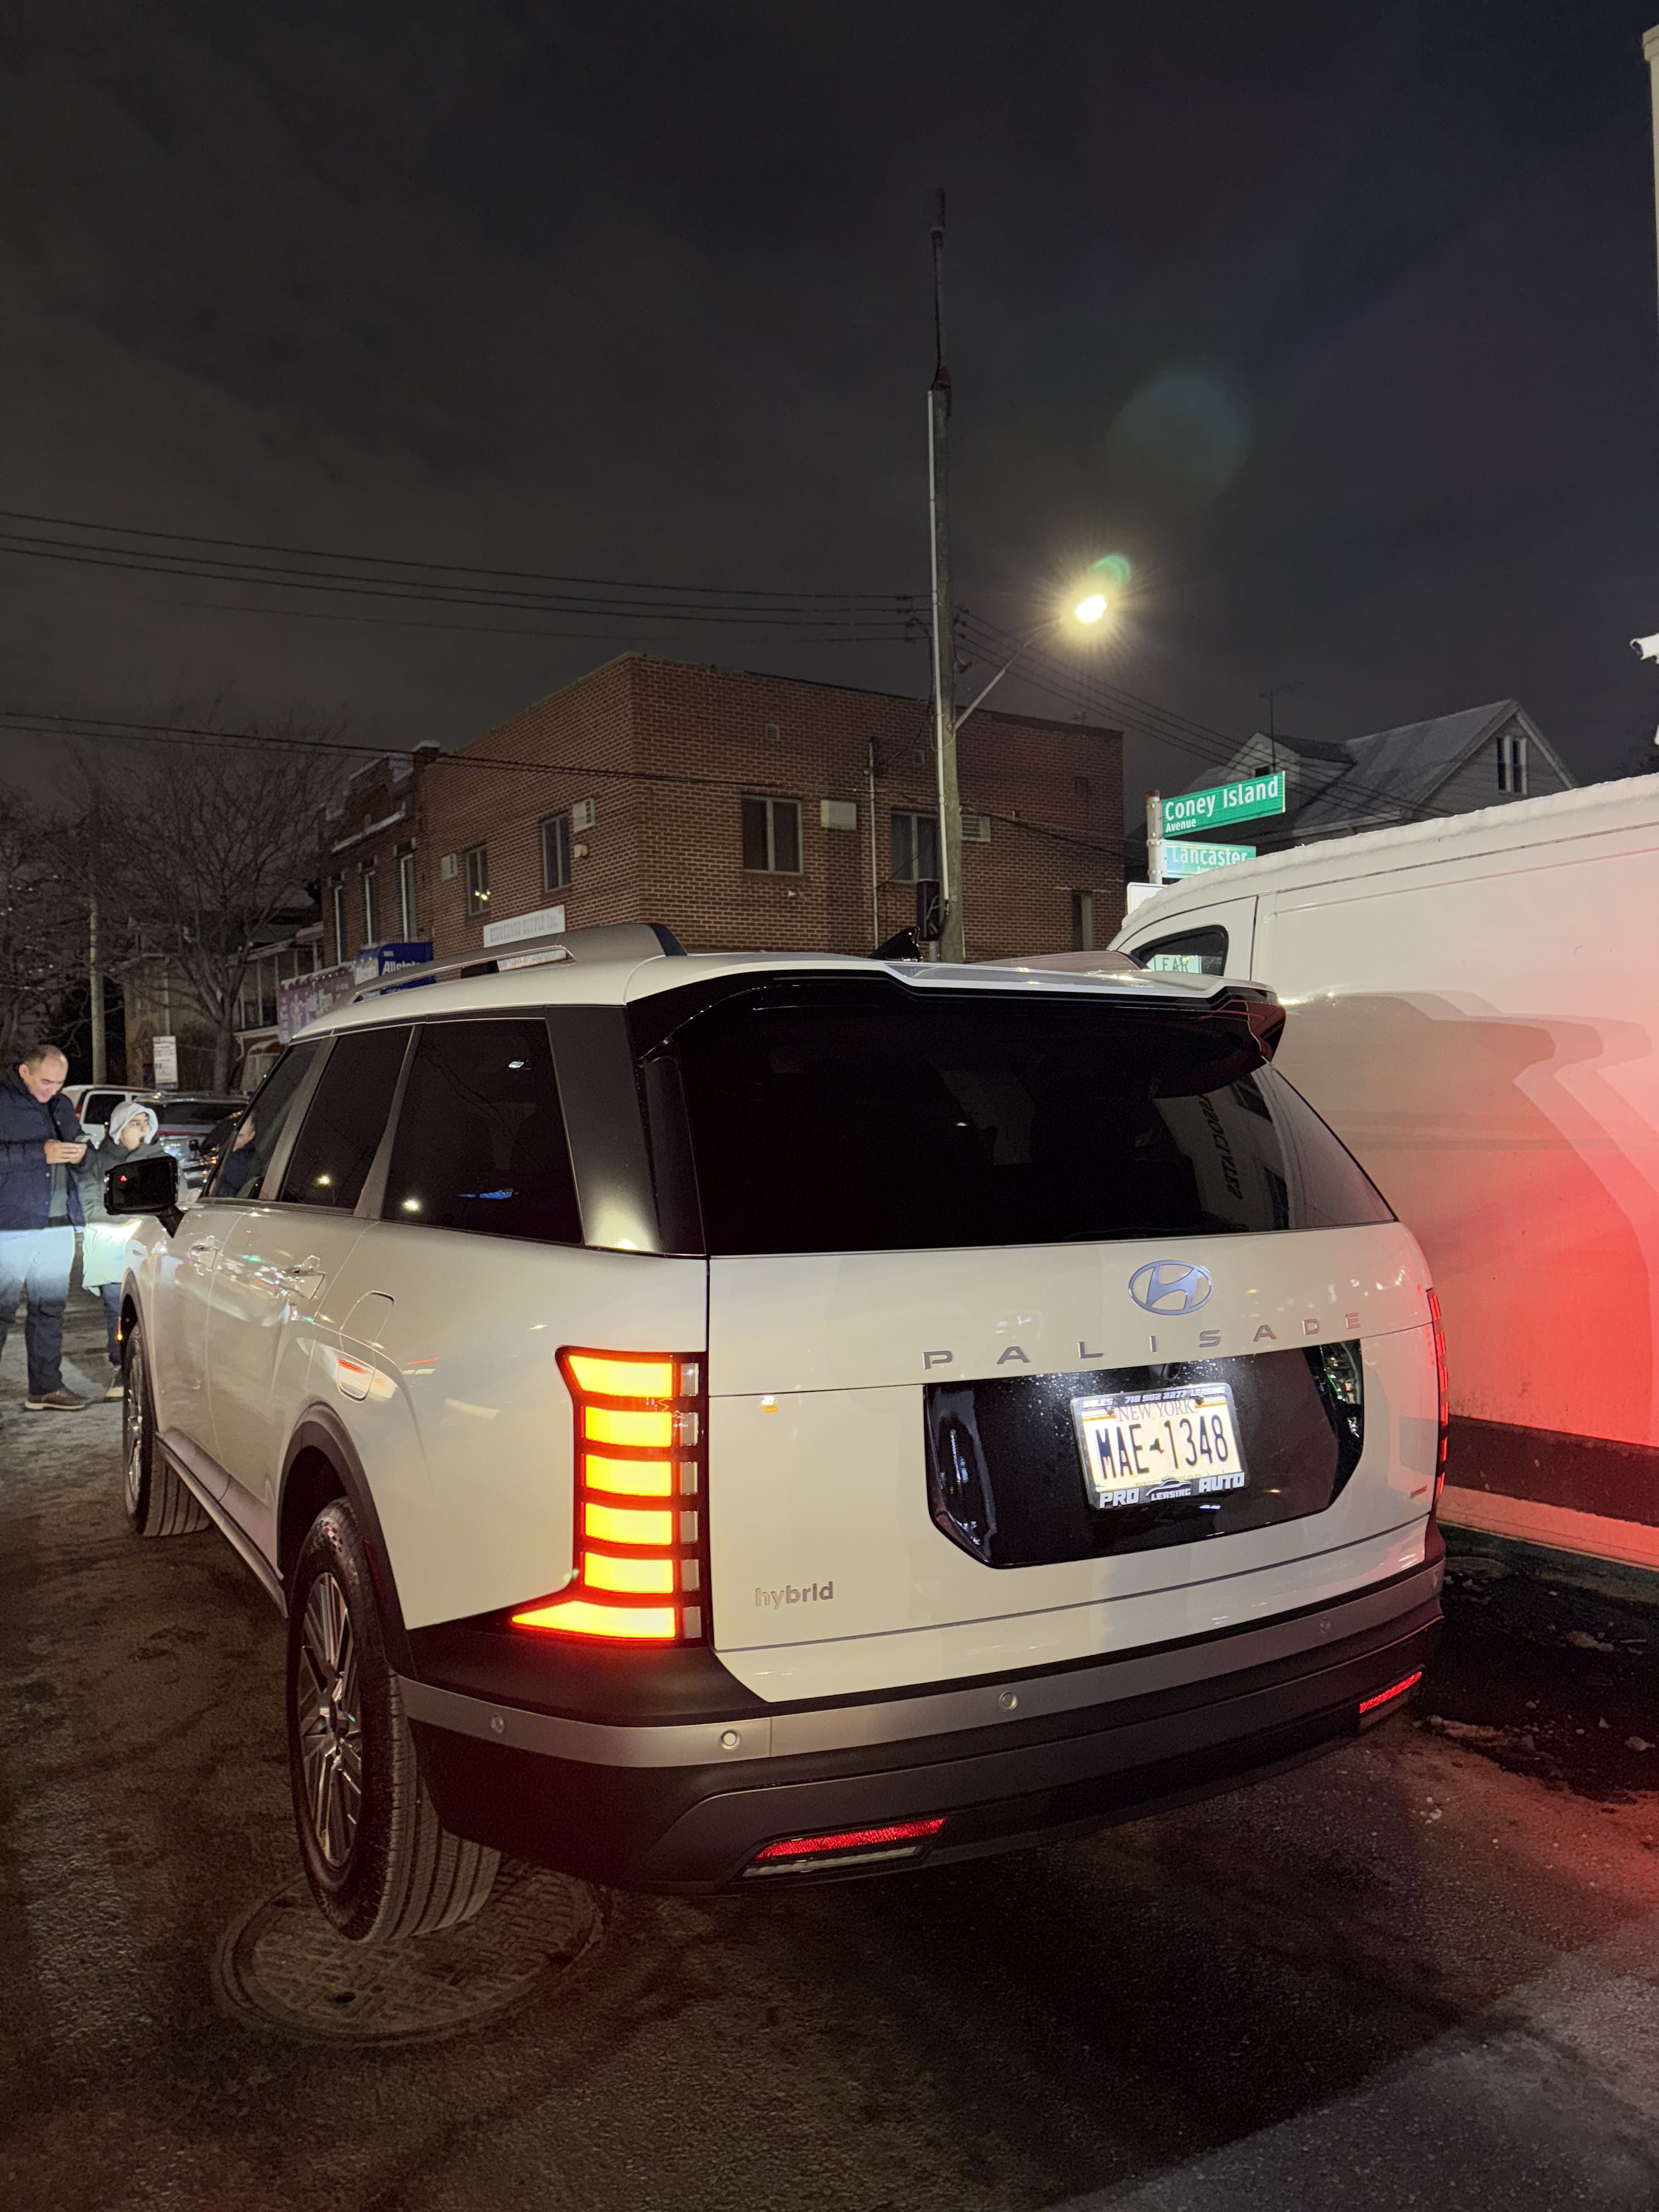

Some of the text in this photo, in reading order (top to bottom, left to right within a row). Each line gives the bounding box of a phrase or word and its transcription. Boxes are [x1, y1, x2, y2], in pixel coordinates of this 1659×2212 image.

[1165, 775, 1278, 821] Coney Island
[1166, 819, 1197, 833] Avenue
[1172, 847, 1248, 866] Lancaster
[923, 1313, 1362, 1370] PALISADE
[1083, 1386, 1226, 1408] SALES 718 902 2277 LEASING
[1118, 1399, 1194, 1422] NEW YORK
[1096, 1414, 1228, 1480] MAE 1348
[1099, 1488, 1140, 1509] PRO
[1198, 1472, 1245, 1493] AUTO
[1150, 1488, 1192, 1502] LEASING
[755, 1581, 834, 1610] hybrid
